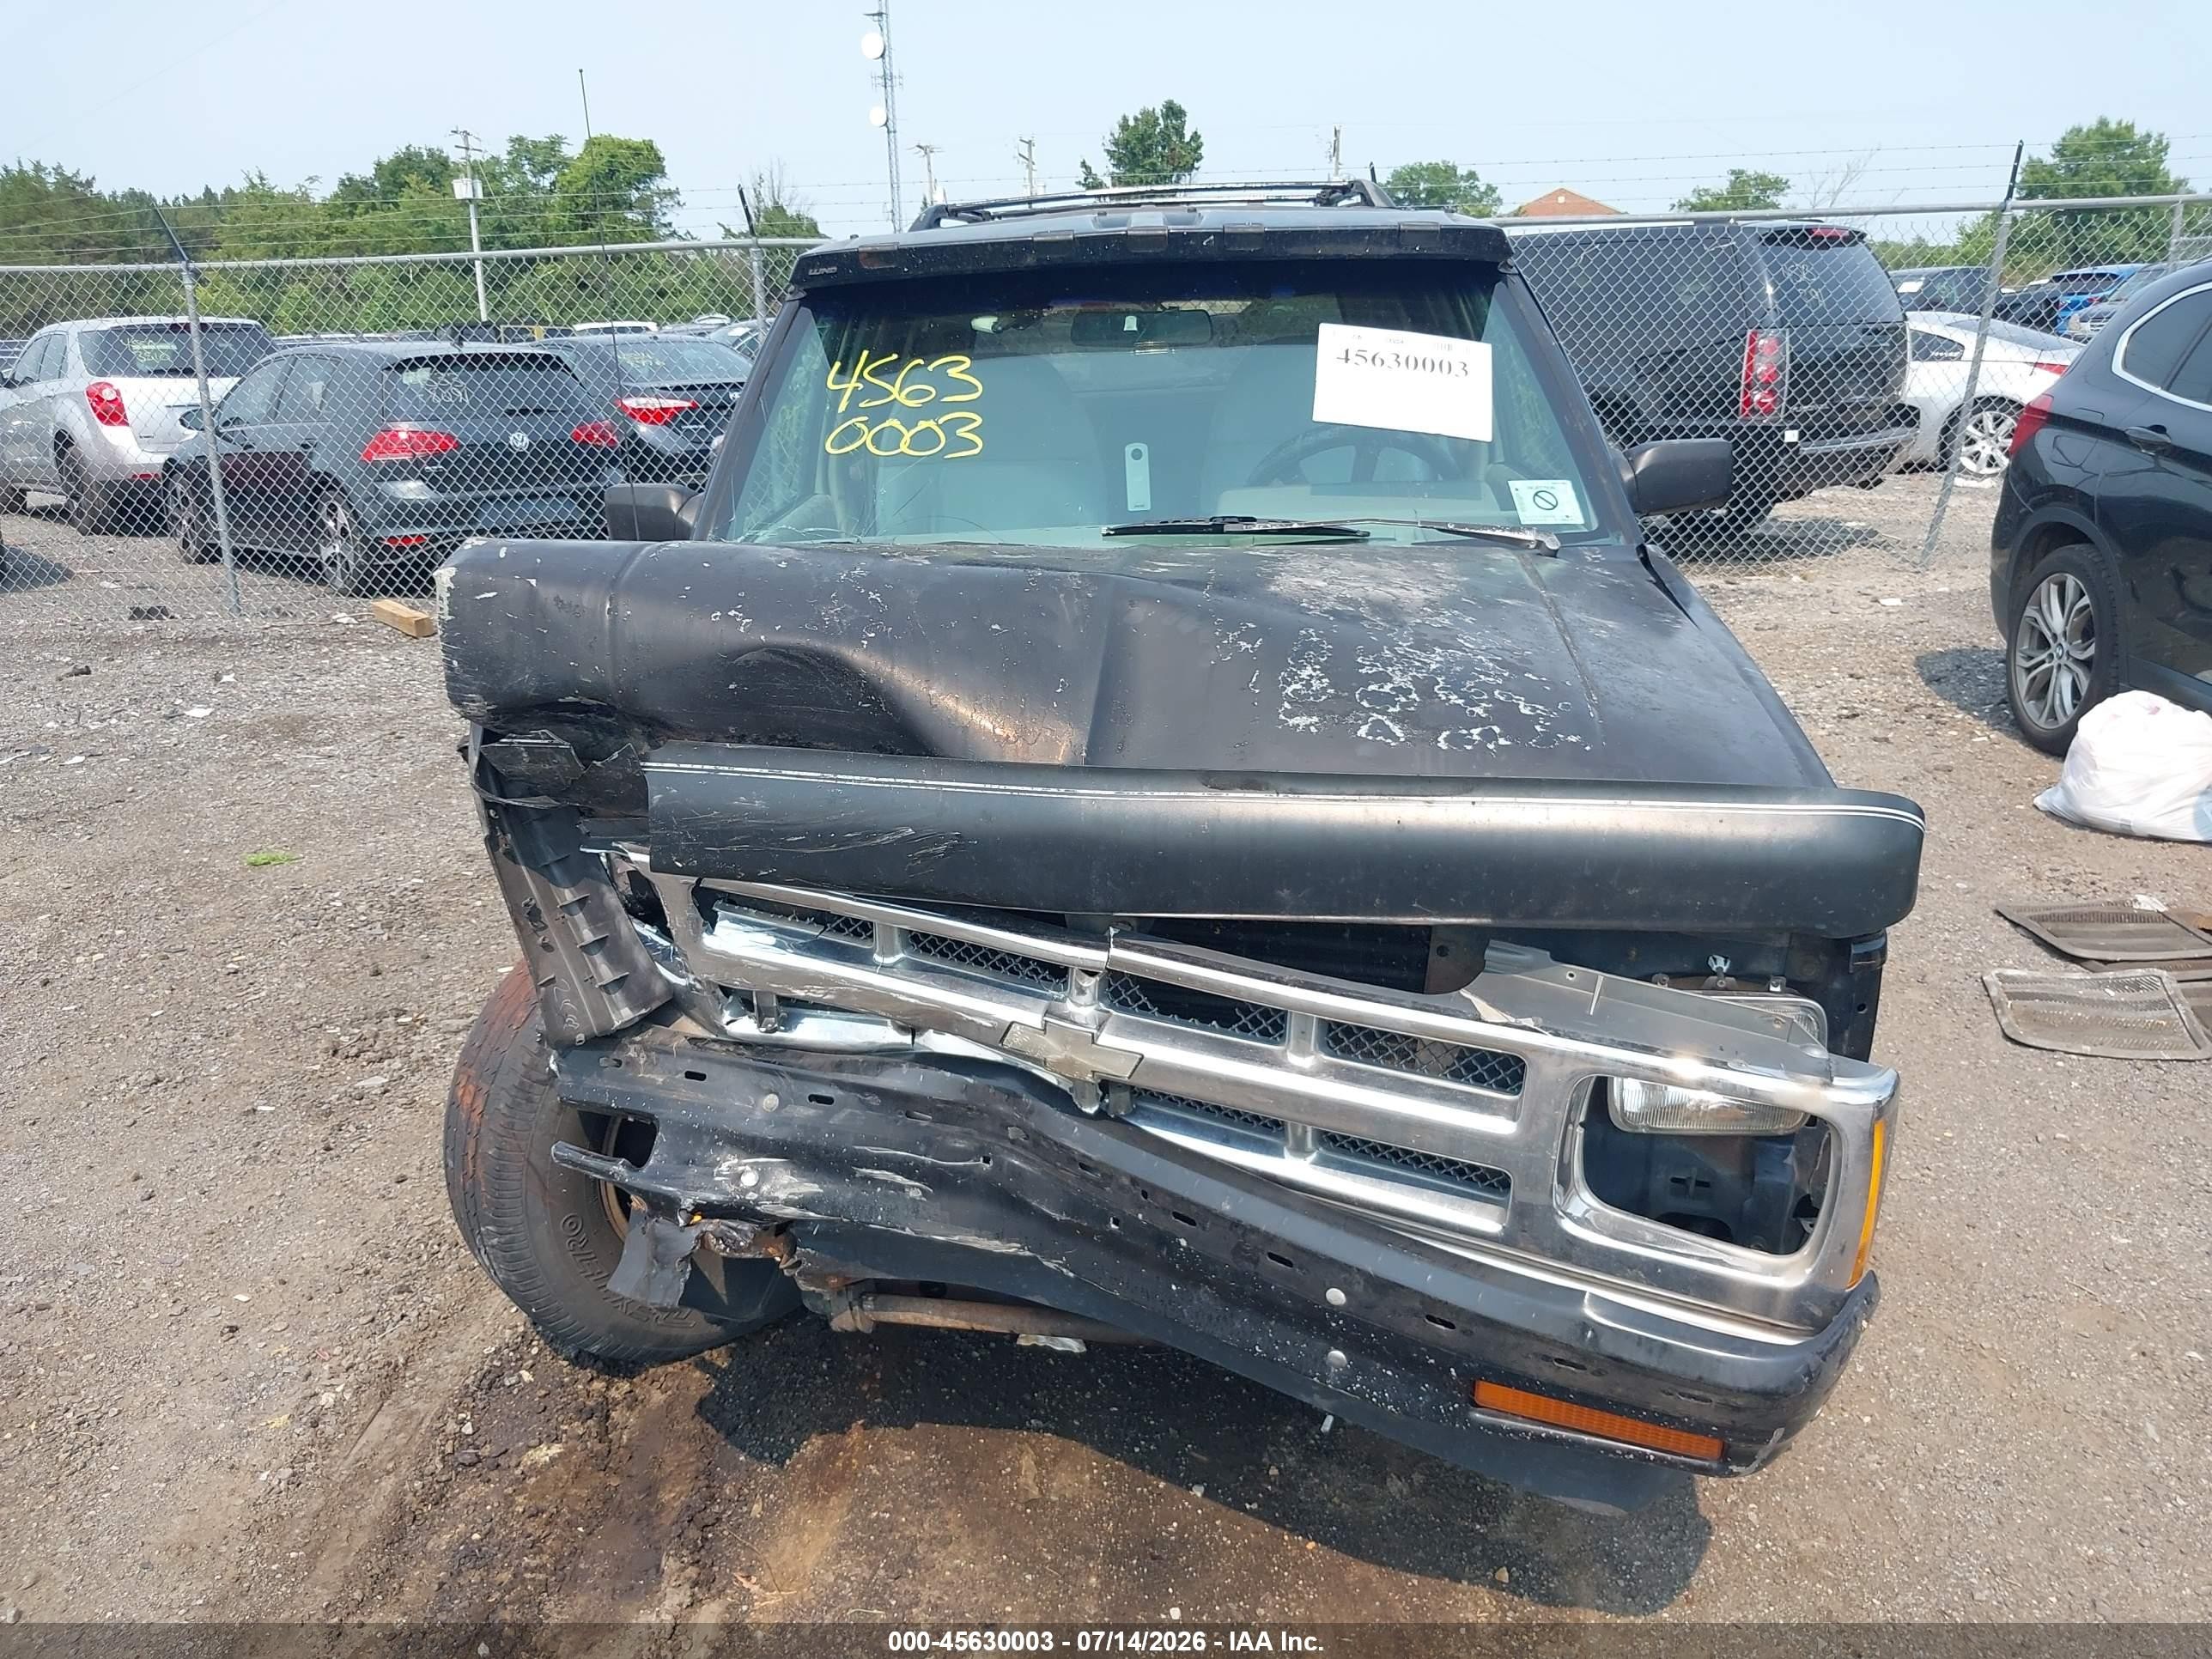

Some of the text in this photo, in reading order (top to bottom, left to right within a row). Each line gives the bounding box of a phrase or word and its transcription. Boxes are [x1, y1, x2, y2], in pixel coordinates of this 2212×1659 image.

[826, 349, 983, 413] 4563
[1336, 347, 1468, 377] 45630003
[824, 411, 983, 459] 0003
